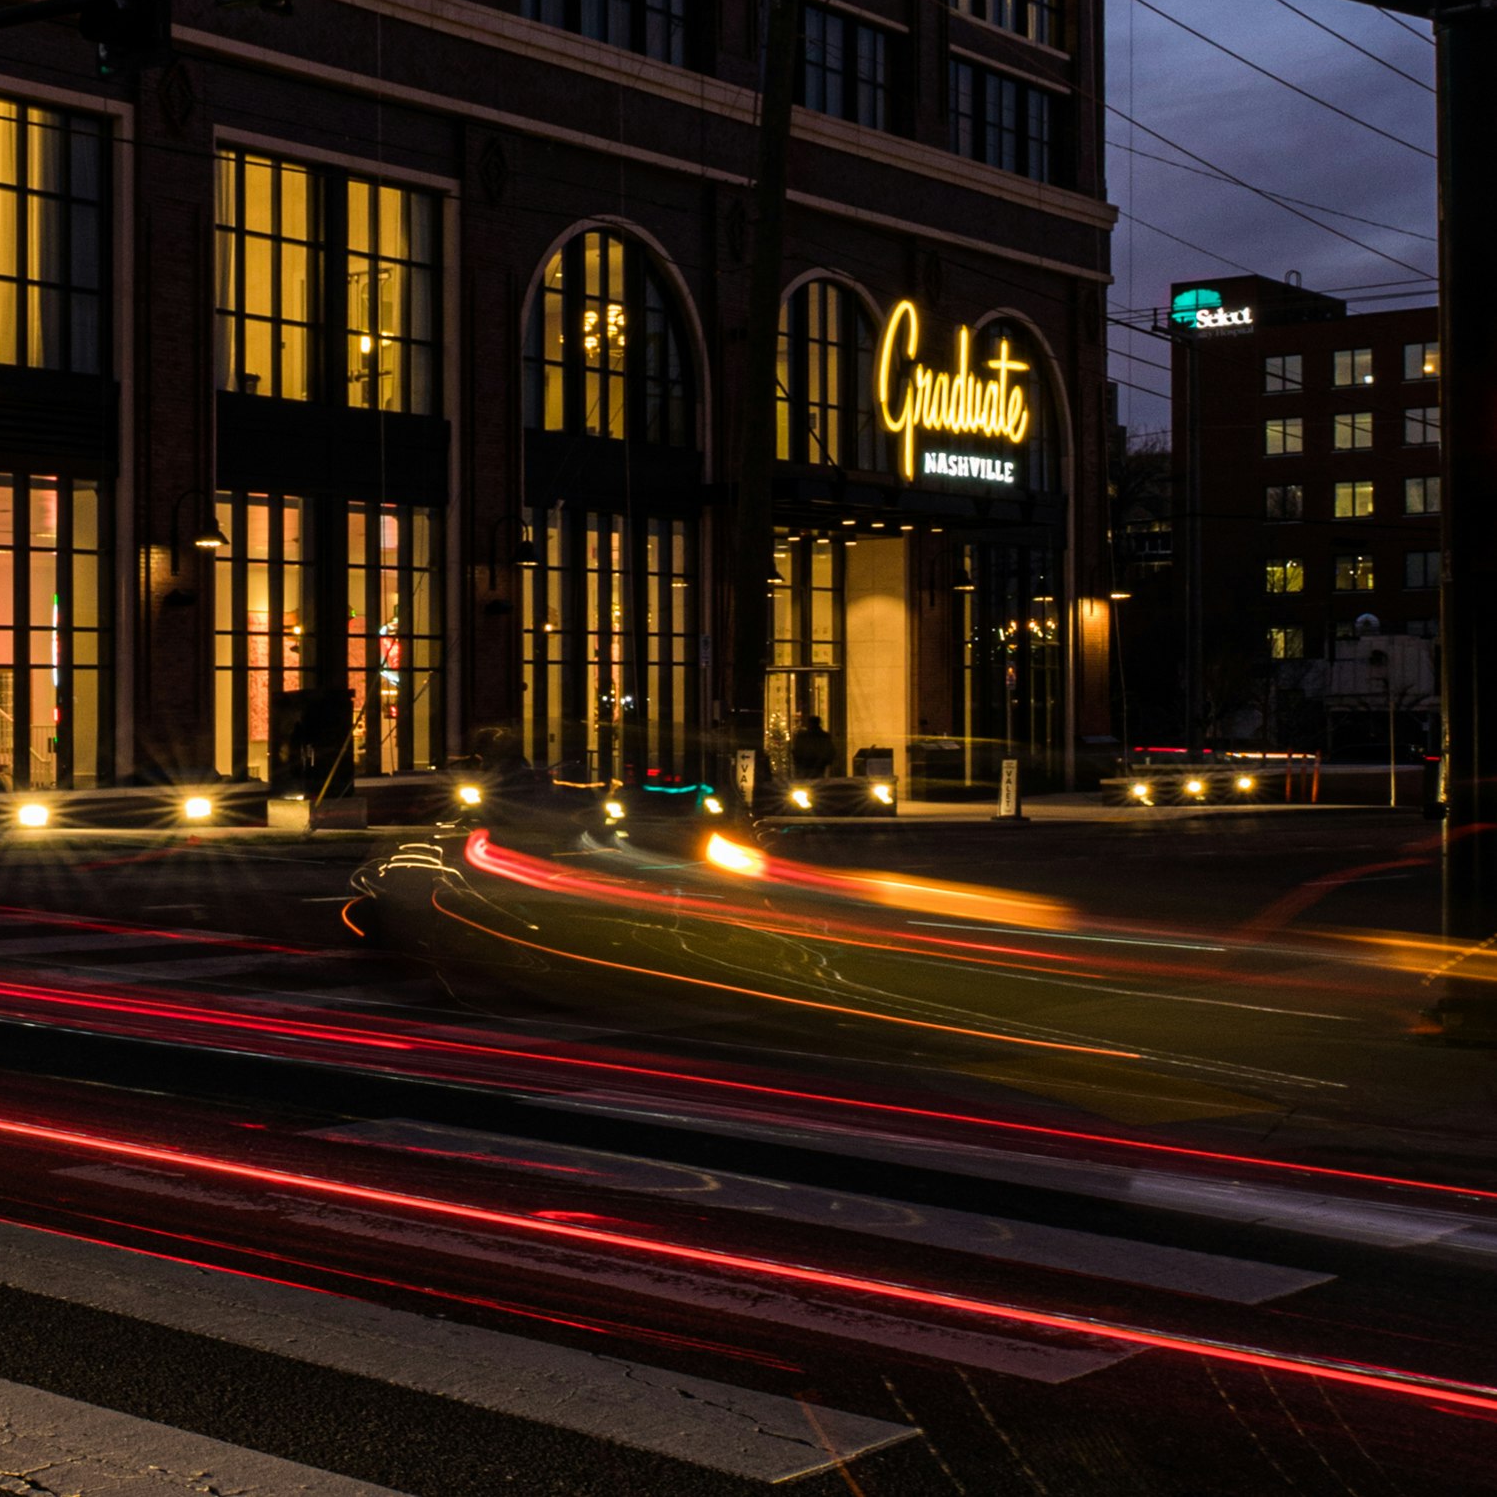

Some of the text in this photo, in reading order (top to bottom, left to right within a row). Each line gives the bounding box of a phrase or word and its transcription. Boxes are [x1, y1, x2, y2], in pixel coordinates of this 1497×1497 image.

[1196, 307, 1253, 329] Select
[879, 300, 1030, 482] Graduate
[925, 452, 1015, 483] NASHVILLE
[1005, 770, 1013, 807] VALET
